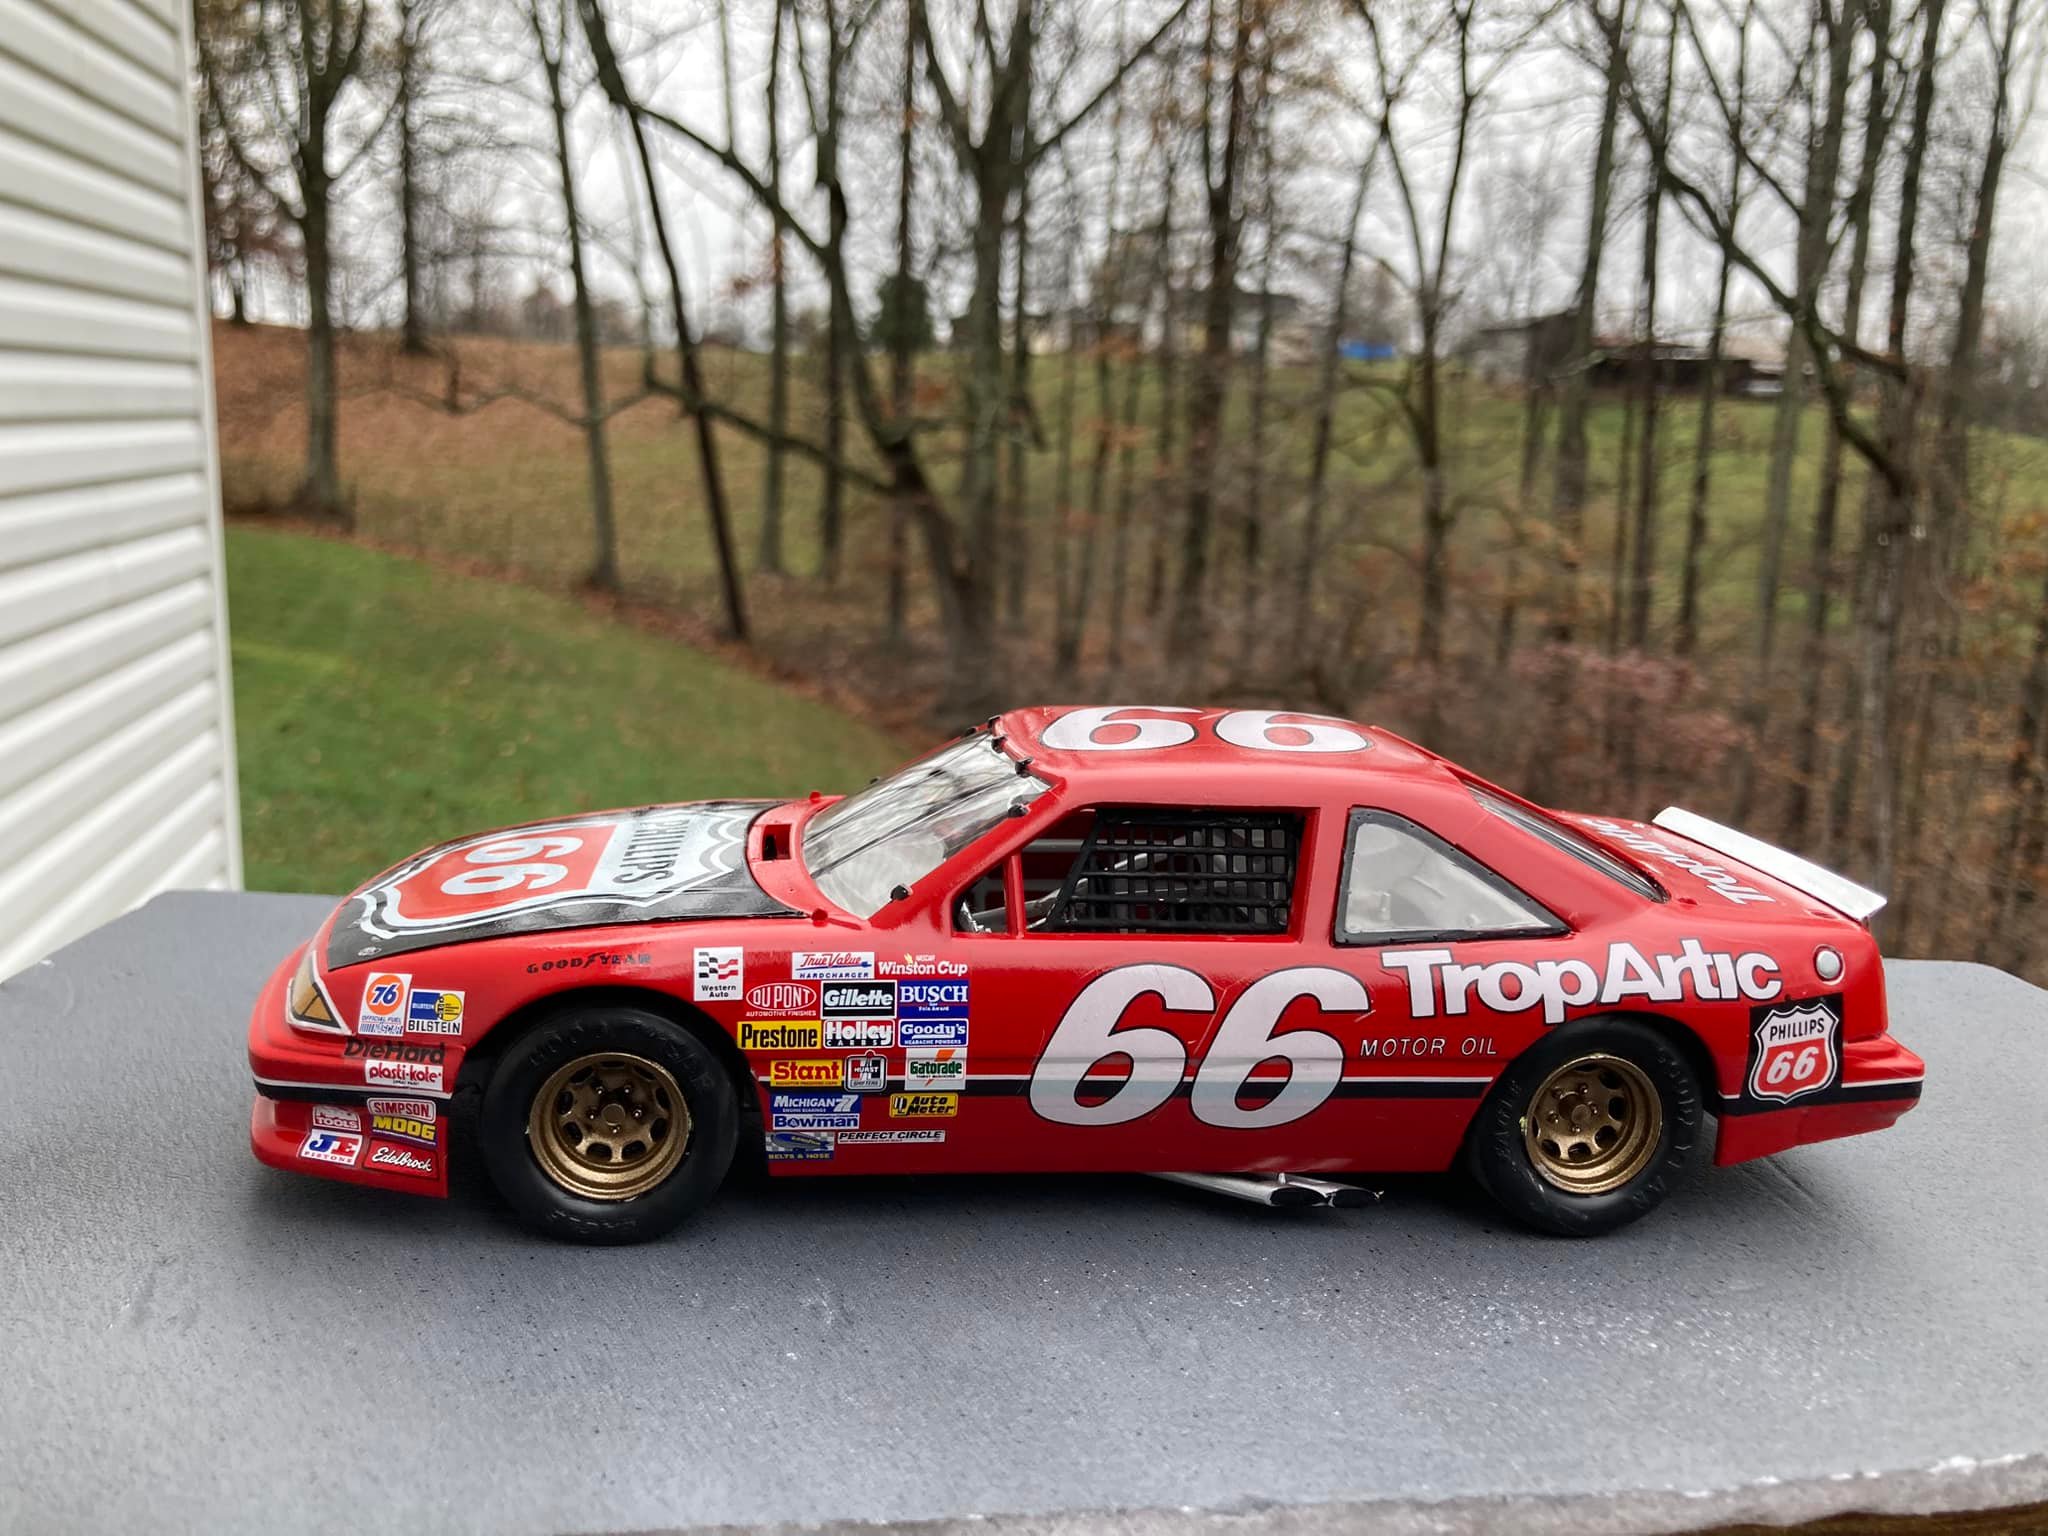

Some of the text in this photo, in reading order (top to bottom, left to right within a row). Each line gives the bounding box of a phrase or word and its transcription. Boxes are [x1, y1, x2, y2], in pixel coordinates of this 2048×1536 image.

[1042, 706, 1366, 752] 66
[613, 819, 691, 884] PHILLIPS
[440, 836, 583, 895] 66
[526, 951, 651, 974] GOODYEAR
[878, 960, 968, 976] Winston Cup
[1382, 938, 1782, 1024] TropArtic
[371, 984, 398, 1005] 76
[824, 988, 894, 1006] Gillette
[900, 986, 968, 1002] BUSCH
[408, 1020, 461, 1034] BILSTEIN
[741, 1023, 818, 1048] Prestone
[826, 1021, 893, 1045] Holley
[901, 1023, 966, 1039] Goody's
[1769, 1018, 1825, 1041] PHILLIPS
[344, 1037, 446, 1064] DieHard
[1030, 963, 1372, 1128] 66
[1359, 1037, 1498, 1058] MOTOR OIL
[774, 1061, 840, 1080] Stant
[910, 1061, 963, 1074] Gatorade
[1766, 1046, 1819, 1084] 66
[374, 1102, 430, 1117] SIMPSON
[773, 1095, 836, 1107] MICHIGAN
[907, 1105, 954, 1115] Meter
[911, 1096, 948, 1105] Auto
[316, 1116, 359, 1129] TOOLS
[373, 1116, 436, 1141] MOOG
[774, 1115, 858, 1128] Bowman
[309, 1134, 359, 1157] JE
[898, 1131, 943, 1139] CIRCLE
[372, 1147, 432, 1172] Edelbrock
